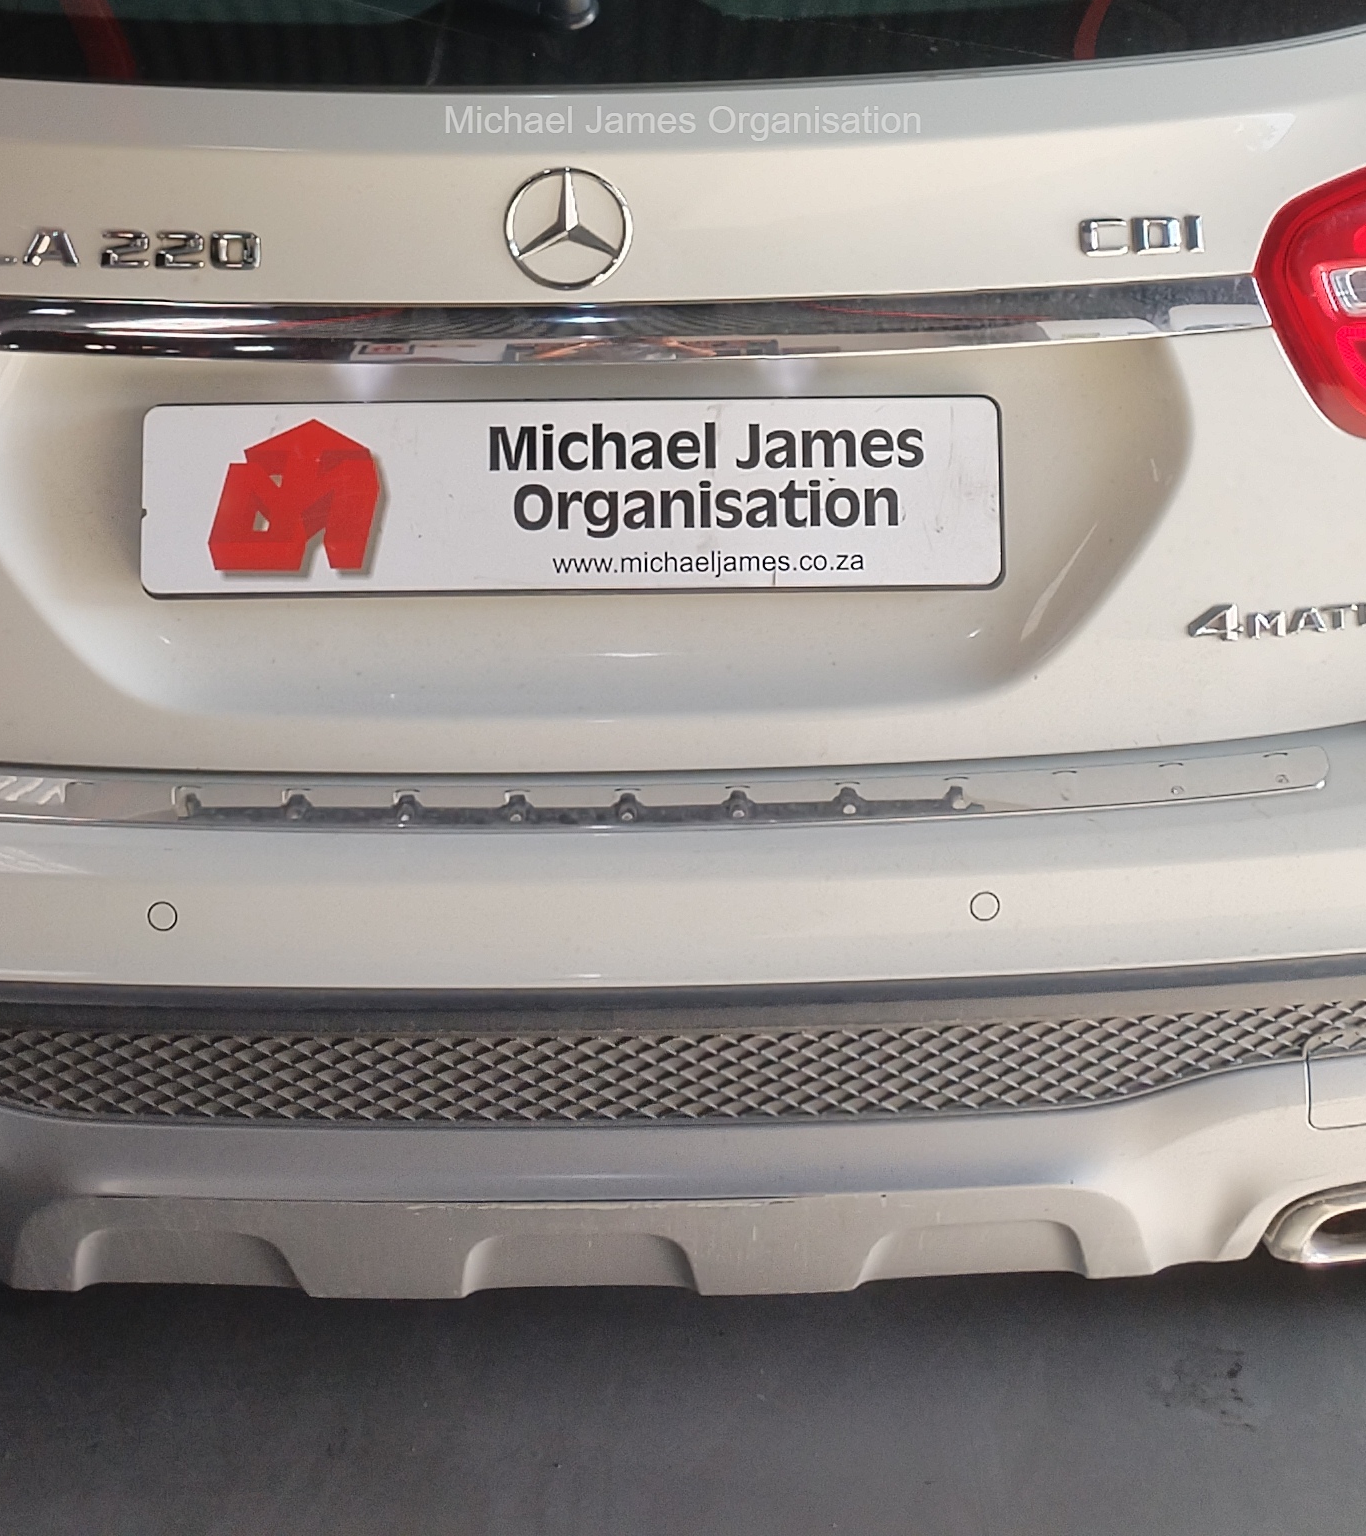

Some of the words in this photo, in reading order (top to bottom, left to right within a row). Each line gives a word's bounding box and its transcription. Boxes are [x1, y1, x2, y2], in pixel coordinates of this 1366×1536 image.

[100, 229, 263, 270] 220
[1078, 214, 1205, 257] CDI
[489, 422, 717, 473] Michael
[735, 422, 925, 470] James
[513, 479, 900, 539] Organisation
[552, 549, 865, 579] www.michaeljames.co.za
